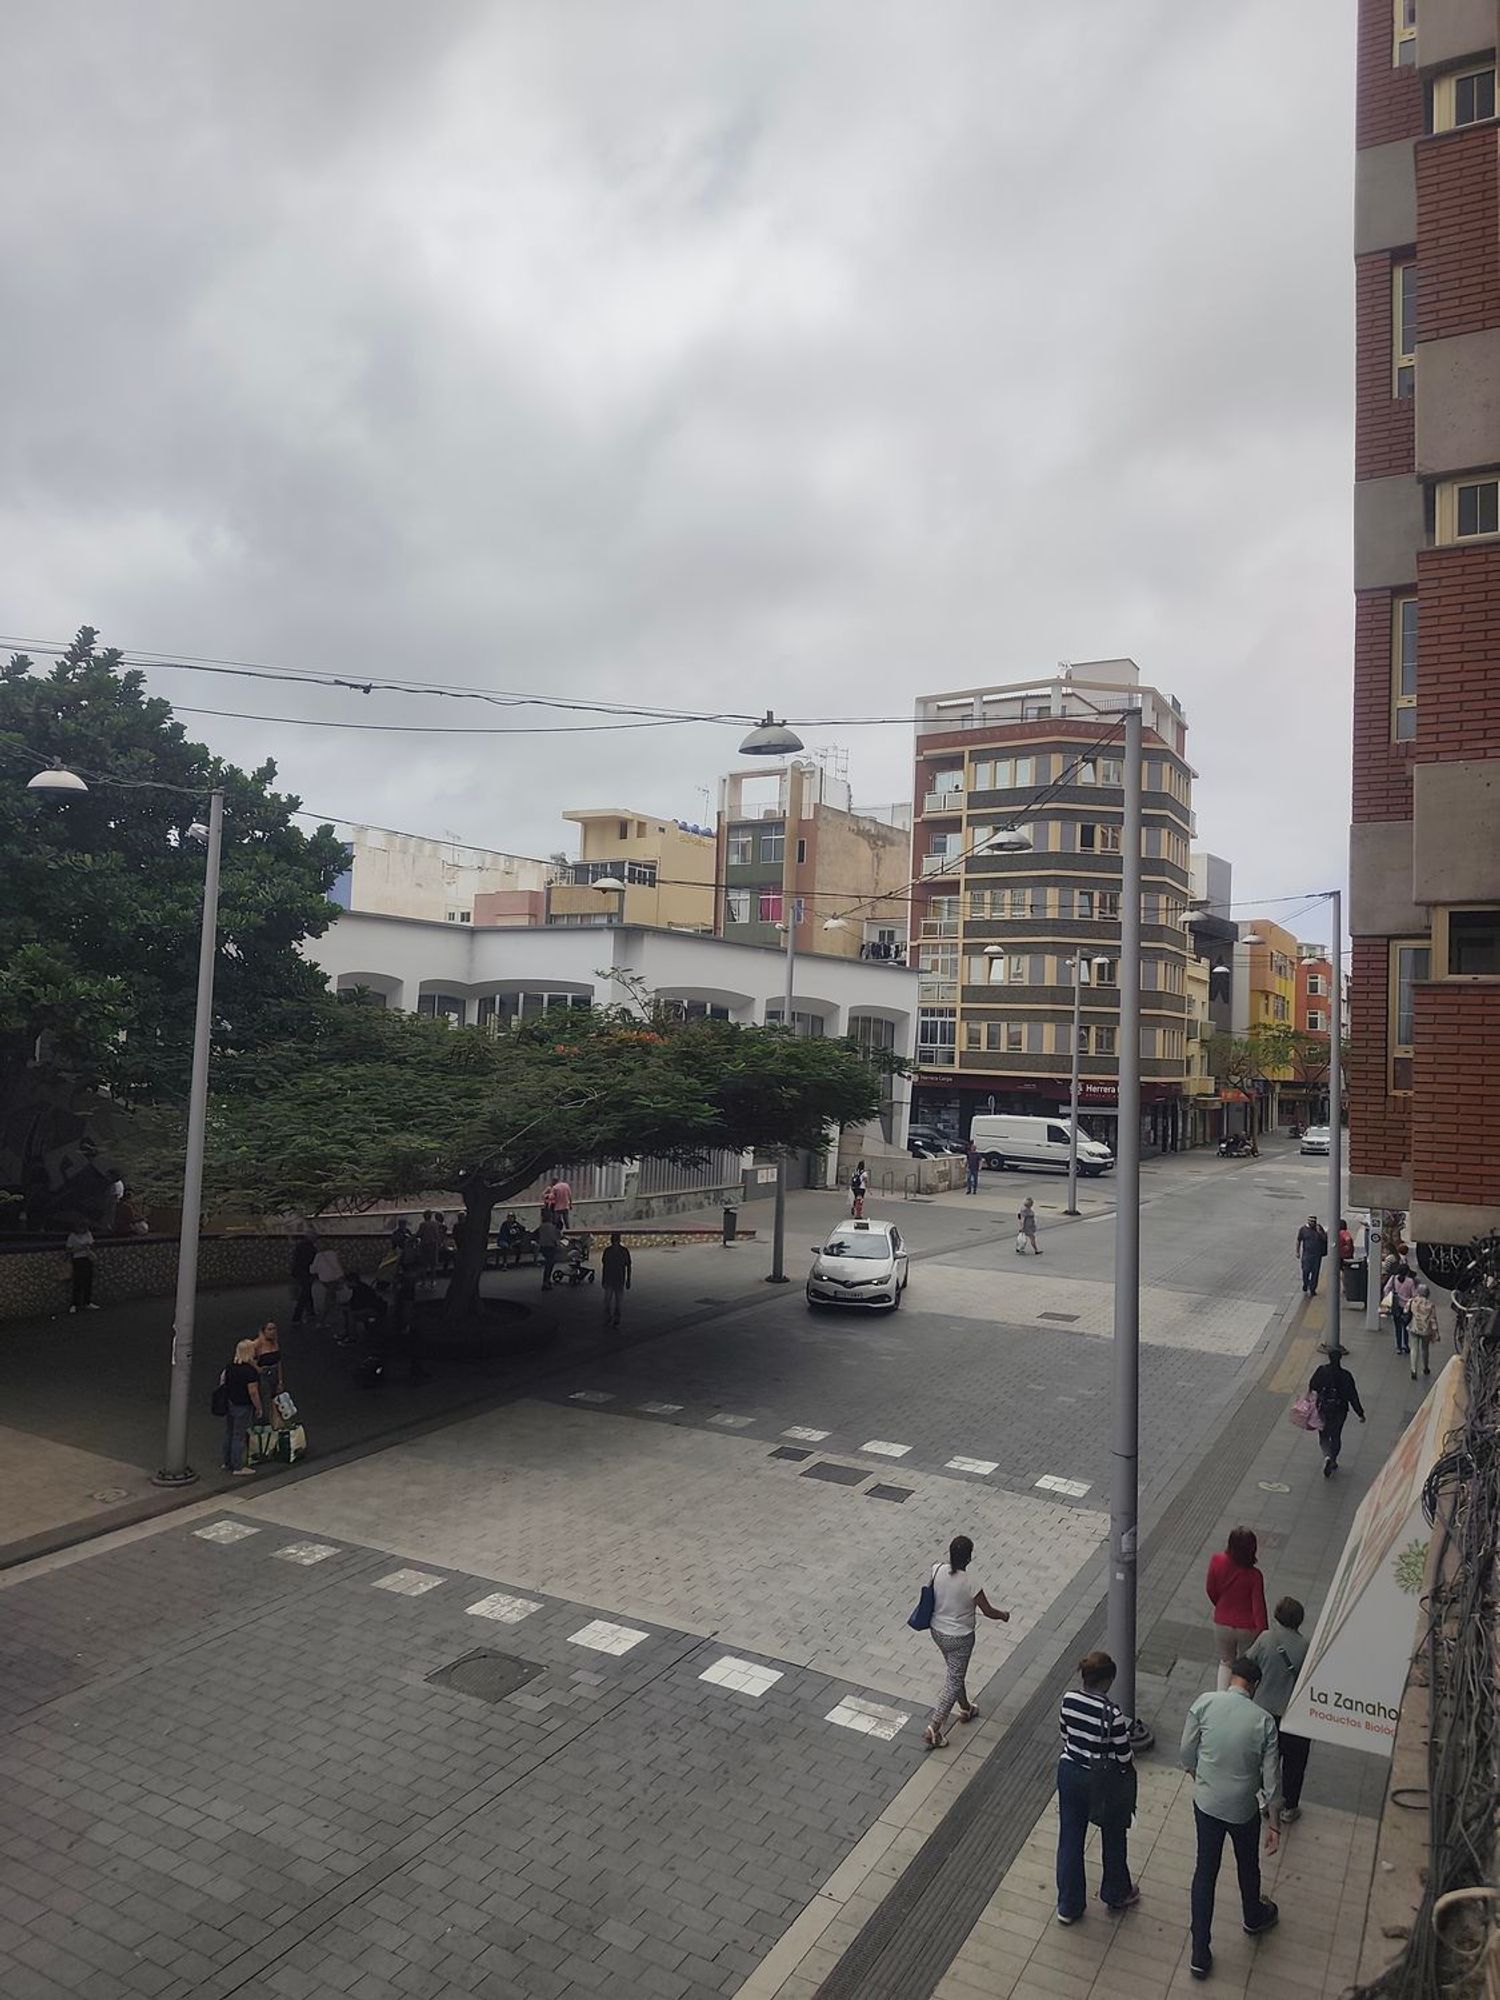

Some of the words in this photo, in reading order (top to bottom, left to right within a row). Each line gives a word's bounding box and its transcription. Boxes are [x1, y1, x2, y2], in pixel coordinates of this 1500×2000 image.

[1086, 1084, 1115, 1095] Herrera
[1310, 1686, 1328, 1704] La
[1334, 1692, 1399, 1720] Zanaho
[1309, 1708, 1362, 1728] Productos
